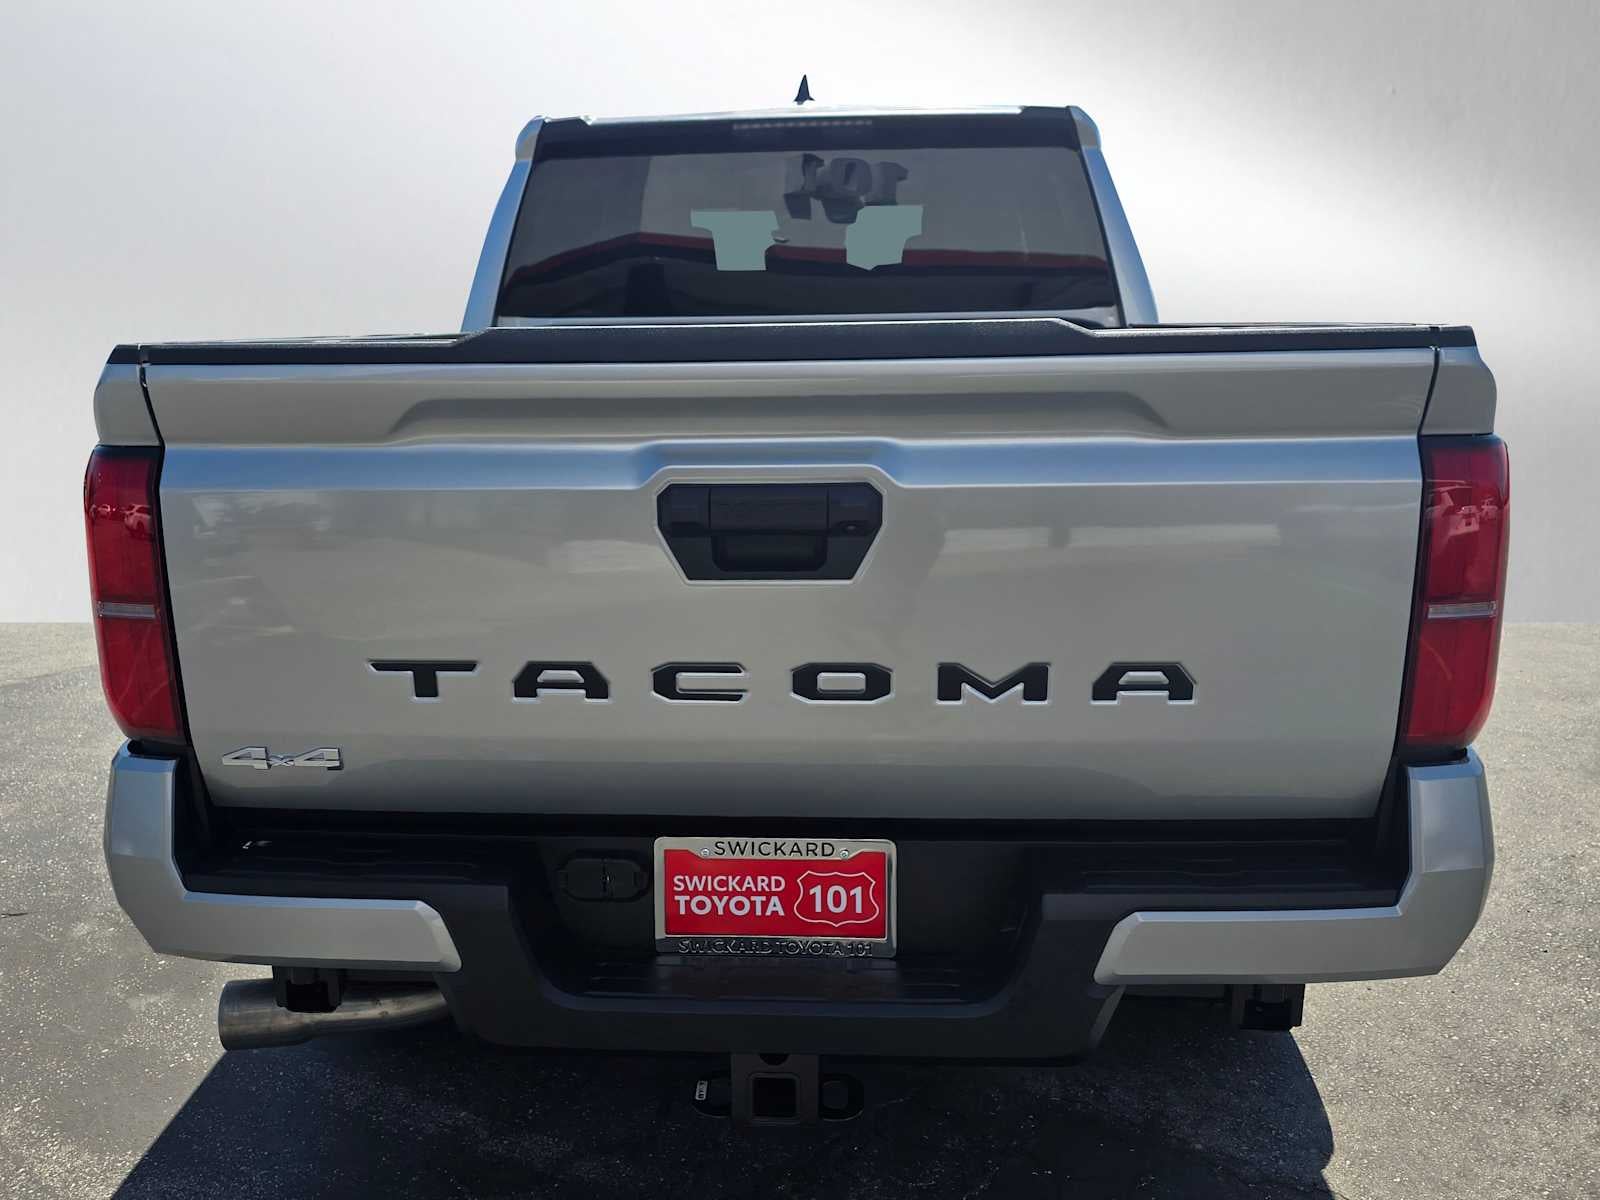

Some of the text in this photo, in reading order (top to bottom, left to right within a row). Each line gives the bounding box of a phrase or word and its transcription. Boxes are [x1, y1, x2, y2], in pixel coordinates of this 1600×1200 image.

[368, 660, 1196, 704] TACOMA
[222, 746, 342, 770] 4x4
[714, 840, 836, 858] SWICKARD
[673, 875, 786, 892] SWICKARD
[674, 895, 785, 916] TOYOTA
[809, 884, 863, 914] 101
[678, 938, 774, 954] SWICKARD
[775, 940, 844, 956] TOYOTA
